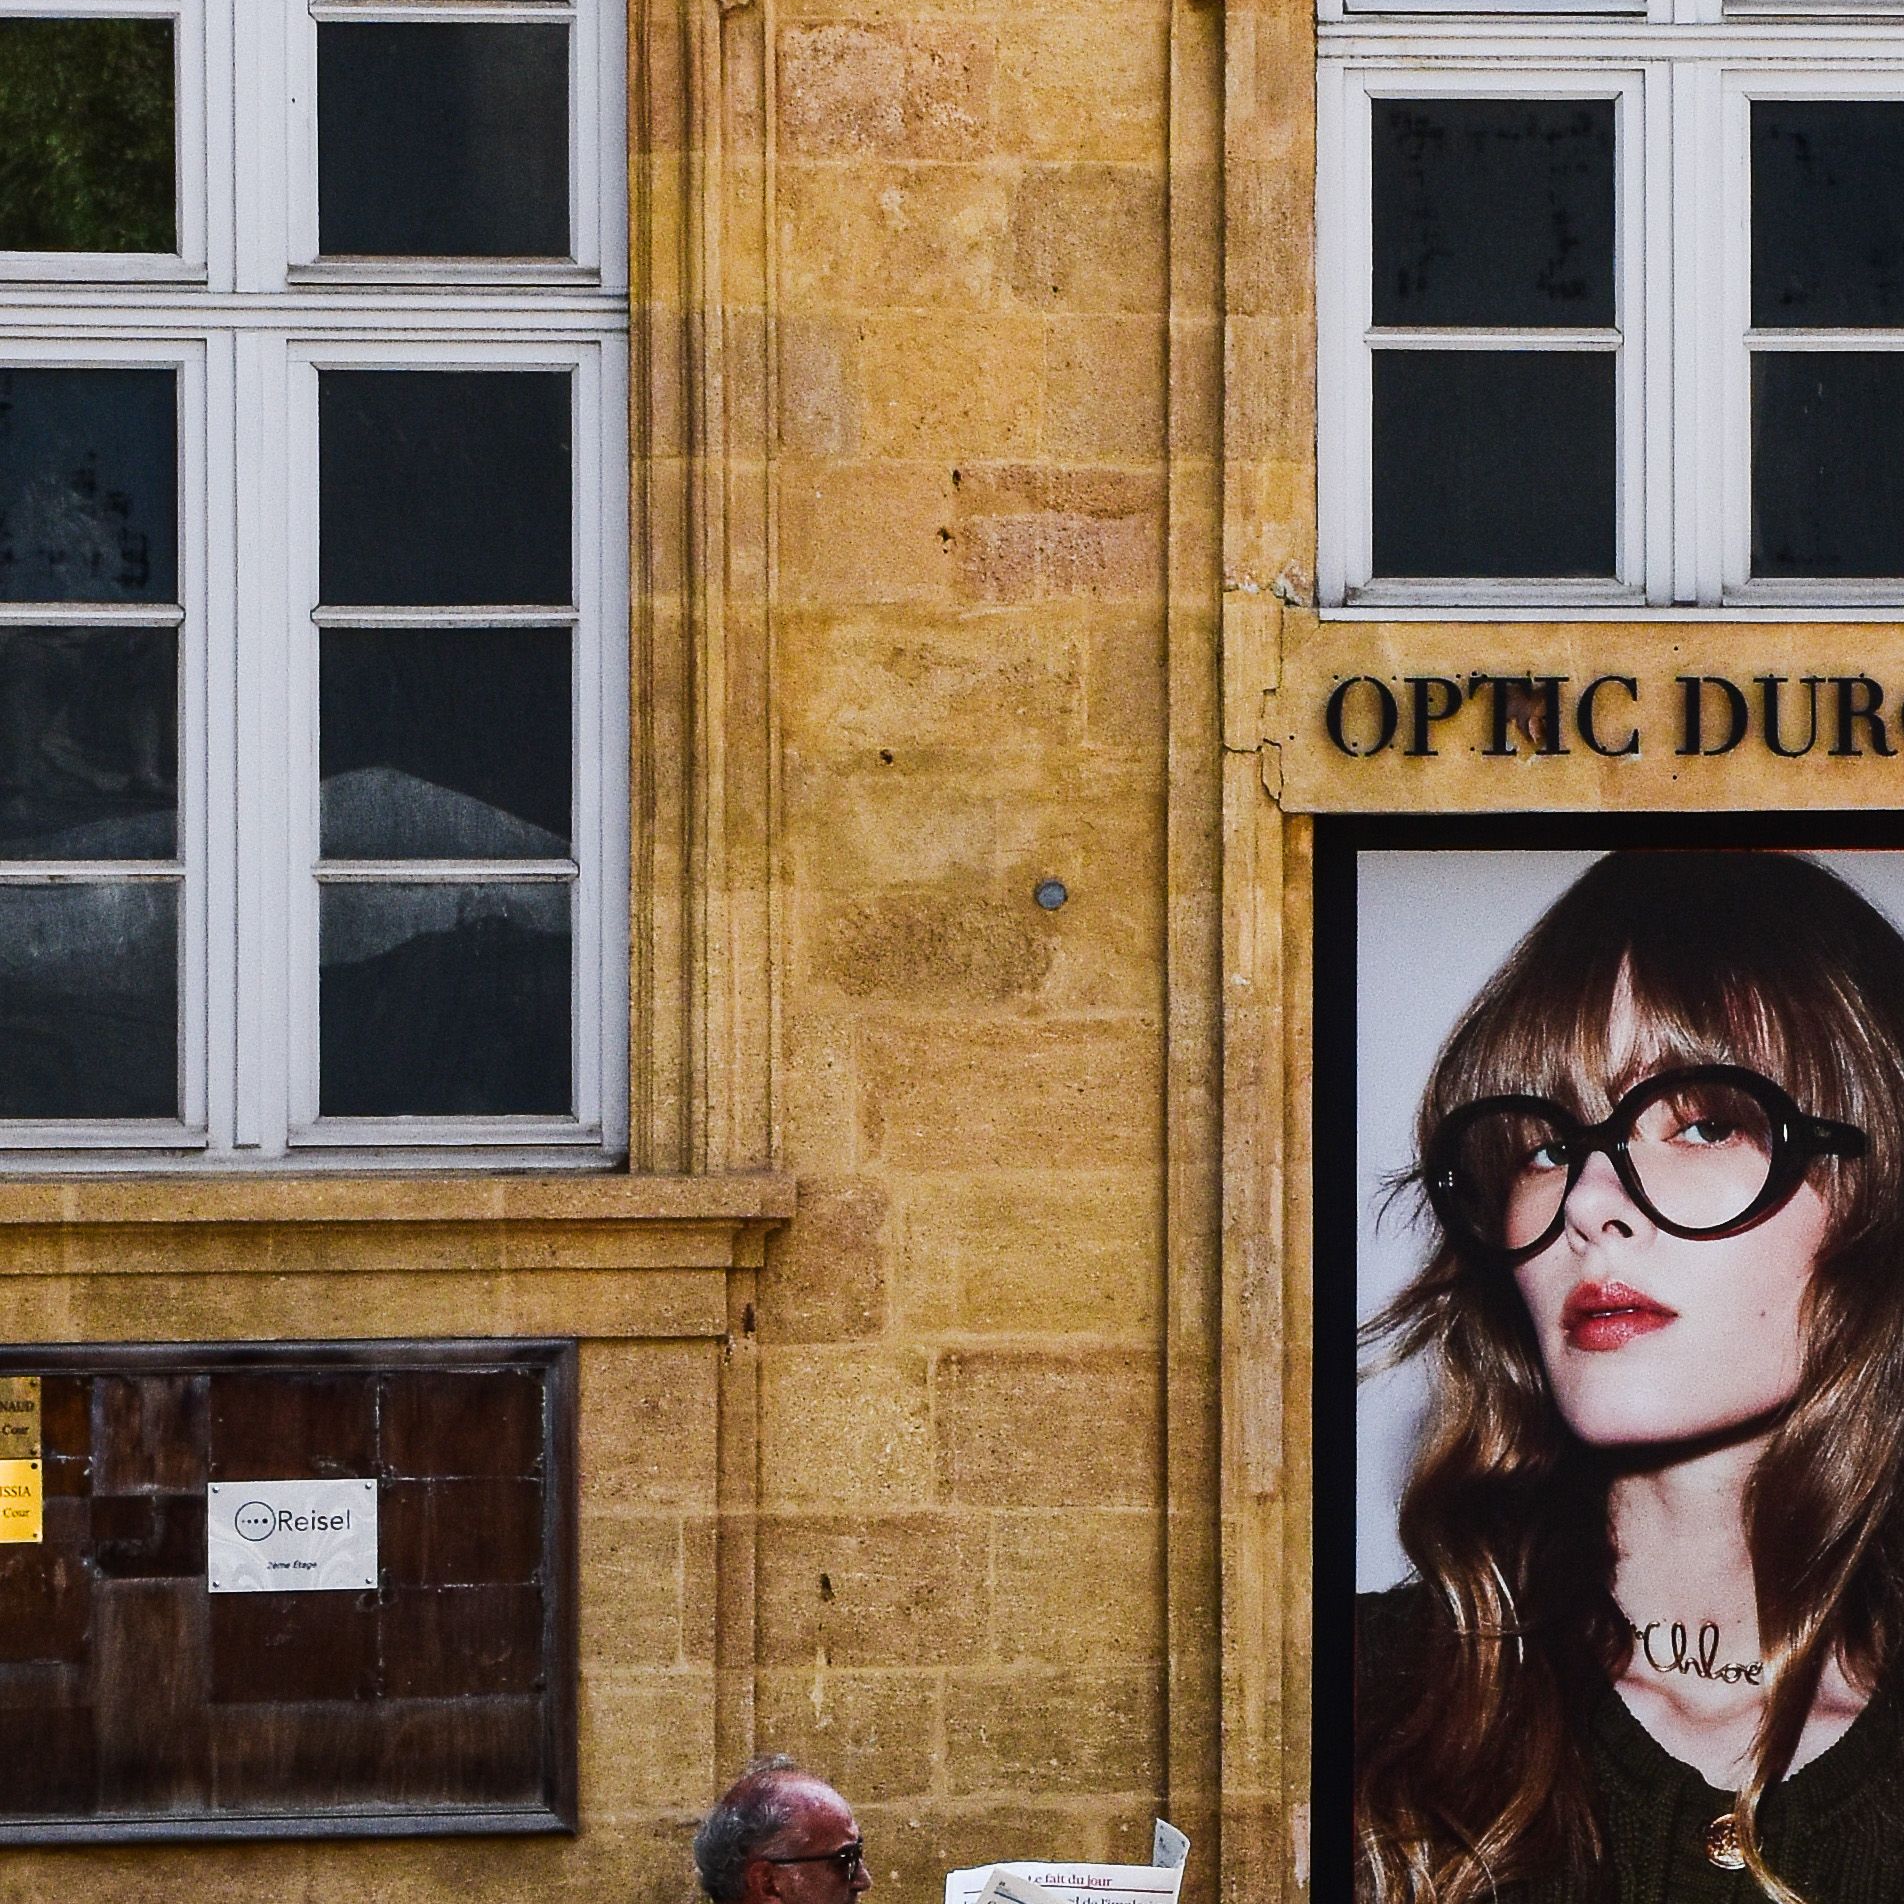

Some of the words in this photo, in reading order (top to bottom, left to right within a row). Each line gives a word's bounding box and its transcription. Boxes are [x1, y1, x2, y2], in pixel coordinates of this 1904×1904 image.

[1326, 675, 1640, 758] OPTIC
[0, 1486, 31, 1498] SSIA
[278, 1509, 351, 1532] Reisel
[1045, 1872, 1066, 1885] fait
[1068, 1873, 1084, 1885] du
[1087, 1874, 1113, 1887] jour
